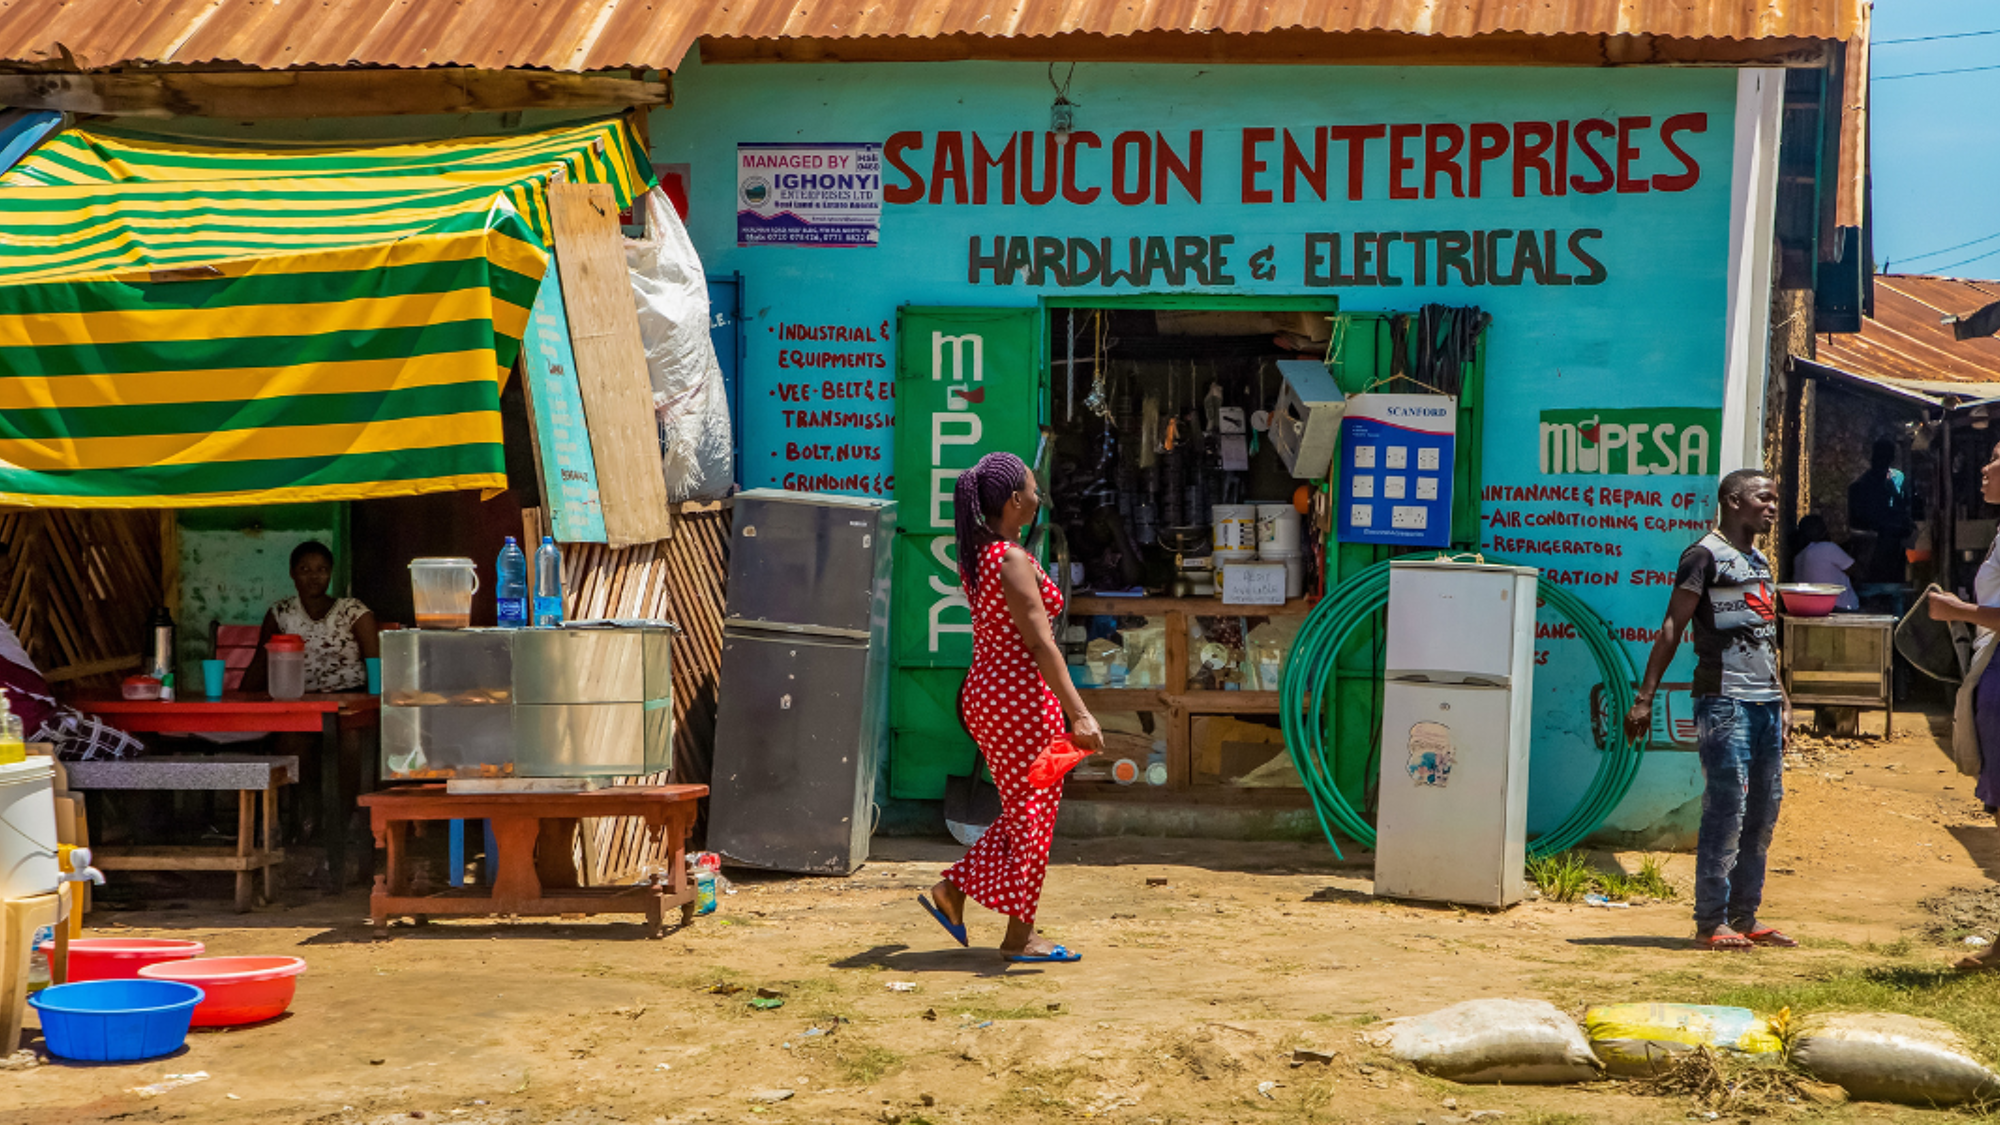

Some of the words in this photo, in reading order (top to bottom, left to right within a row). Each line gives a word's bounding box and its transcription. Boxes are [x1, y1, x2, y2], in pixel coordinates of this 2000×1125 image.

[742, 155, 823, 169] MANAGED
[828, 155, 850, 169] BY
[883, 130, 1203, 205] SAMUCON
[1241, 112, 1708, 204] ENTERPRISES
[774, 174, 879, 190] IGHONYI
[780, 191, 850, 200] ENTERPRISES
[853, 191, 873, 200] LTD
[968, 235, 1235, 286] HARDWARE
[1249, 245, 1276, 281] &
[1304, 229, 1607, 286] ELECTRICALS
[778, 322, 877, 342] INDUSTRIAL
[880, 320, 890, 341] &
[778, 350, 886, 369] EQUIPMENTS
[1387, 406, 1447, 417] SCANFORD
[782, 472, 869, 493] GRINDING
[1583, 485, 1594, 506] &
[1600, 487, 1663, 509] REPAIR
[1671, 493, 1696, 509] OF
[1494, 534, 1622, 557] REFRIGERATORS
